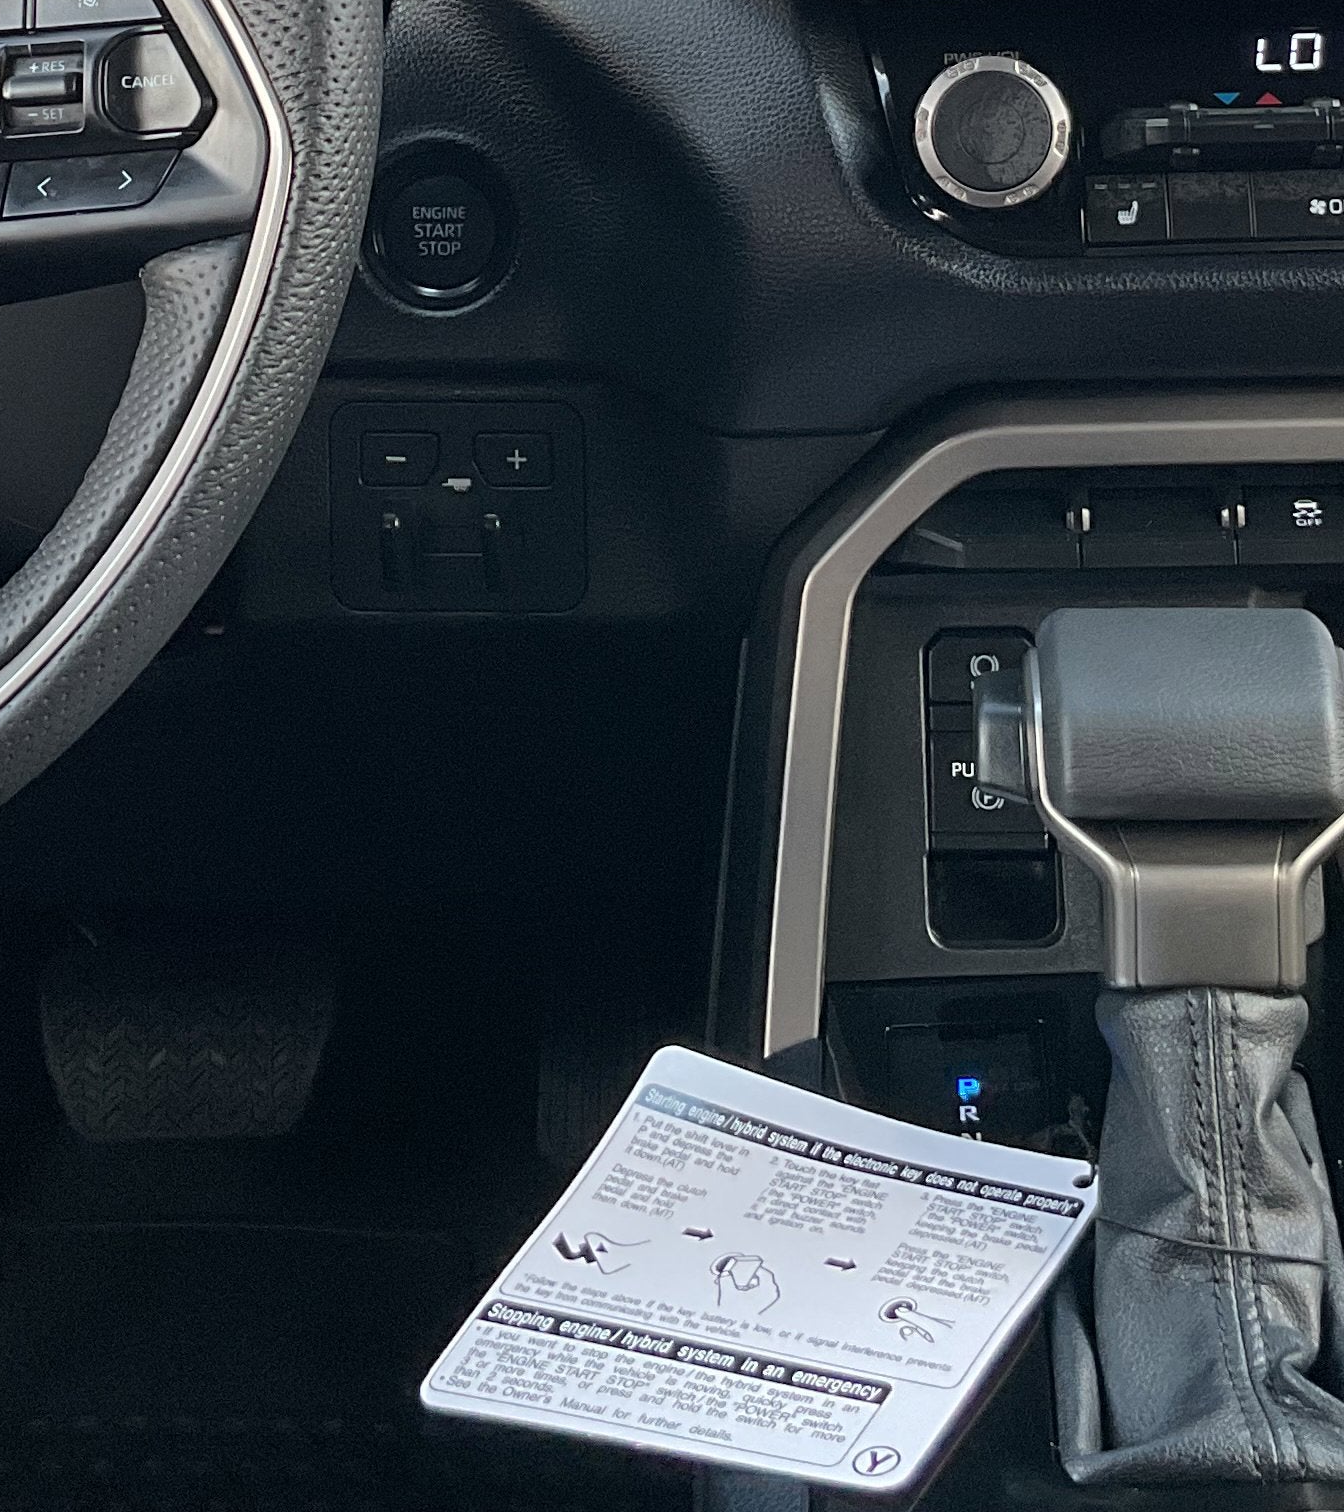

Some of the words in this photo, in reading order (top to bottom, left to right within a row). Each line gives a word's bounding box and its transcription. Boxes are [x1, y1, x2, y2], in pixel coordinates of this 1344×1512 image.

[1256, 31, 1324, 72] LO
[121, 73, 175, 89] CANCEL
[412, 206, 466, 220] ENGINE
[413, 223, 464, 238] START
[418, 241, 461, 256] STOP
[958, 1076, 981, 1102] P
[959, 1105, 981, 1122] R
[644, 1087, 686, 1116] Starting
[767, 1130, 809, 1153] system
[809, 1141, 824, 1156] if
[822, 1145, 843, 1162] the
[843, 1152, 900, 1176] electronic
[900, 1165, 923, 1182] key
[925, 1170, 954, 1187] does
[957, 1179, 980, 1193] not
[980, 1183, 1023, 1203] operate
[487, 1302, 556, 1332] Stopping
[677, 1344, 736, 1369] system
[740, 1356, 760, 1373] in
[762, 1362, 786, 1379] an
[791, 1368, 884, 1401] emergency
[498, 1329, 522, 1342] you
[528, 1336, 560, 1349] want
[563, 1341, 576, 1353] to
[581, 1345, 609, 1361] stop
[614, 1352, 636, 1365] the
[720, 1375, 762, 1394] hybrid
[766, 1386, 815, 1405] system
[822, 1397, 836, 1409] in
[842, 1403, 861, 1415] an
[460, 1356, 470, 1366] 3
[475, 1359, 491, 1370] or
[493, 1362, 526, 1376] more
[577, 1379, 594, 1391] or
[596, 1384, 633, 1399] press
[638, 1393, 666, 1407] and
[671, 1398, 702, 1414] hold
[706, 1405, 729, 1420] the
[735, 1412, 777, 1430] switch
[783, 1421, 805, 1435] for
[810, 1429, 847, 1444] more
[467, 1345, 488, 1359] the
[554, 1364, 601, 1381] START
[655, 1386, 697, 1403] switch
[801, 1416, 844, 1434] switch
[474, 1338, 542, 1359] emergency
[547, 1351, 579, 1366] while
[583, 1356, 606, 1371] the
[613, 1365, 656, 1383] vehicle
[664, 1374, 678, 1387] is
[741, 1392, 788, 1411] quickly
[794, 1405, 833, 1421] press
[446, 1375, 472, 1389] See
[477, 1381, 498, 1395] the
[502, 1385, 554, 1405] Owner's
[560, 1395, 608, 1416] Manual
[611, 1407, 633, 1420] for
[637, 1413, 683, 1432] further
[688, 1423, 733, 1442] details.
[865, 1450, 897, 1474] Y
